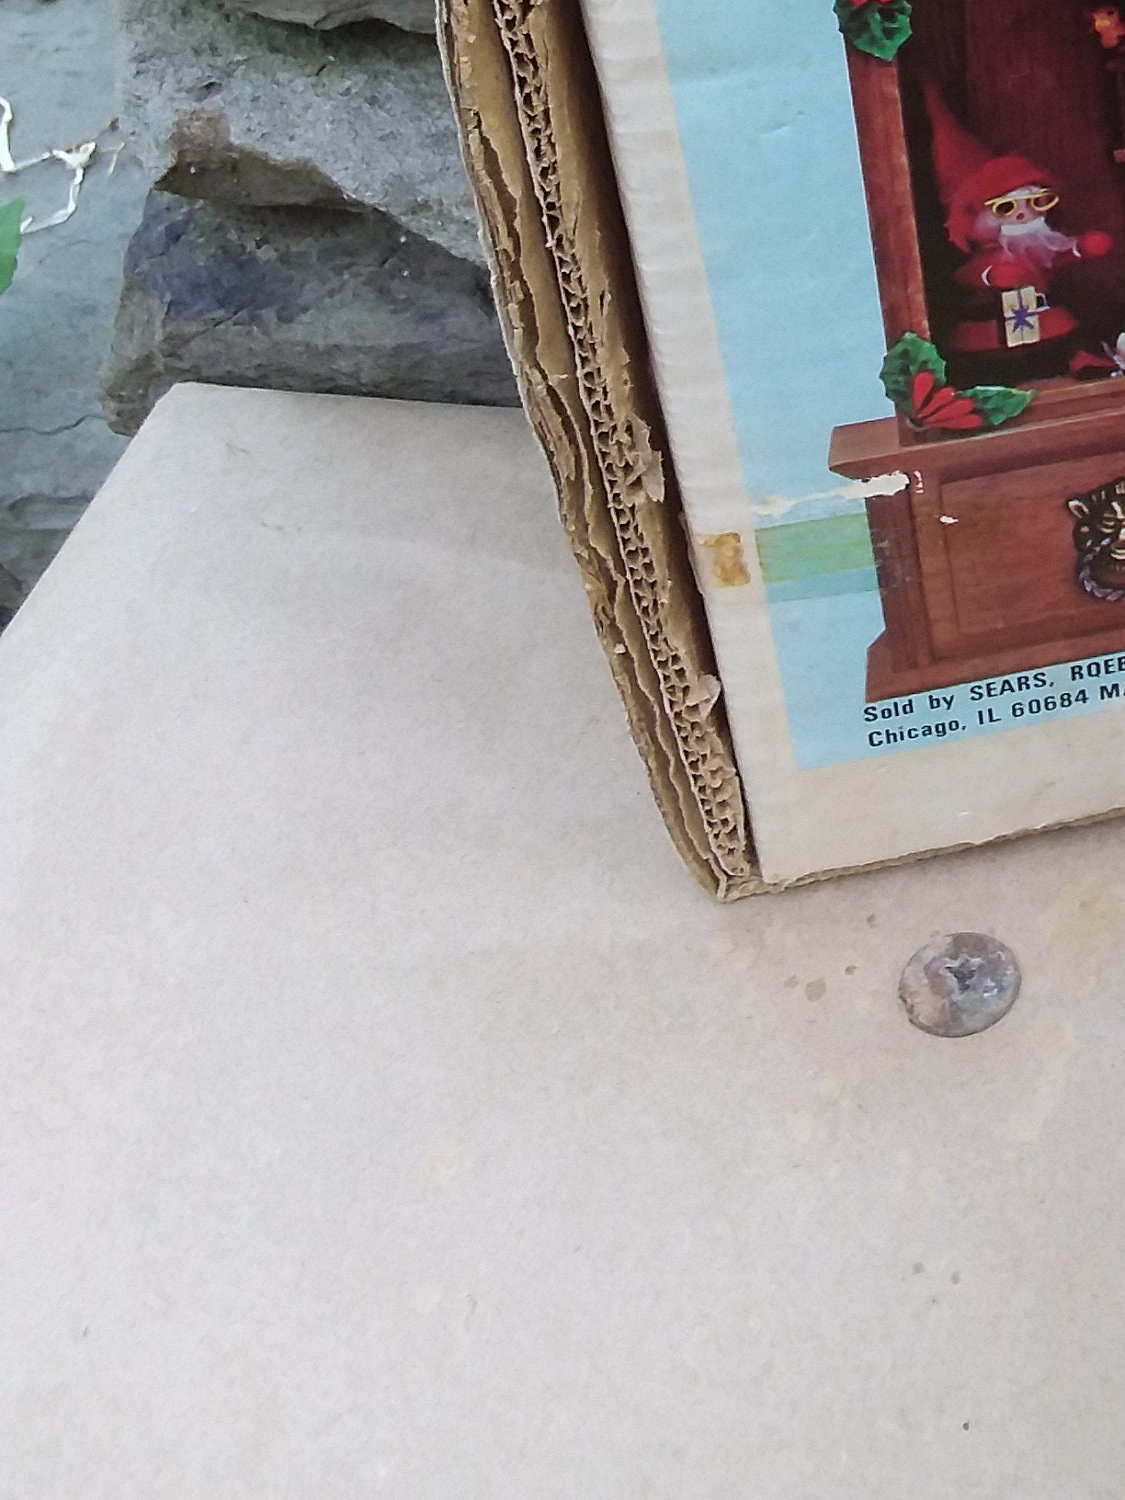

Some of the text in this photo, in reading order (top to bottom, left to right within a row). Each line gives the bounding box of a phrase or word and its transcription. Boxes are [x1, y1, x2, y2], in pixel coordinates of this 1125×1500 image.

[863, 698, 915, 723] Sold
[928, 693, 955, 711] by
[969, 670, 1055, 702] SEARS,
[868, 716, 967, 748] Chicago,
[976, 708, 1002, 726] IL
[1011, 688, 1090, 719] 60684
